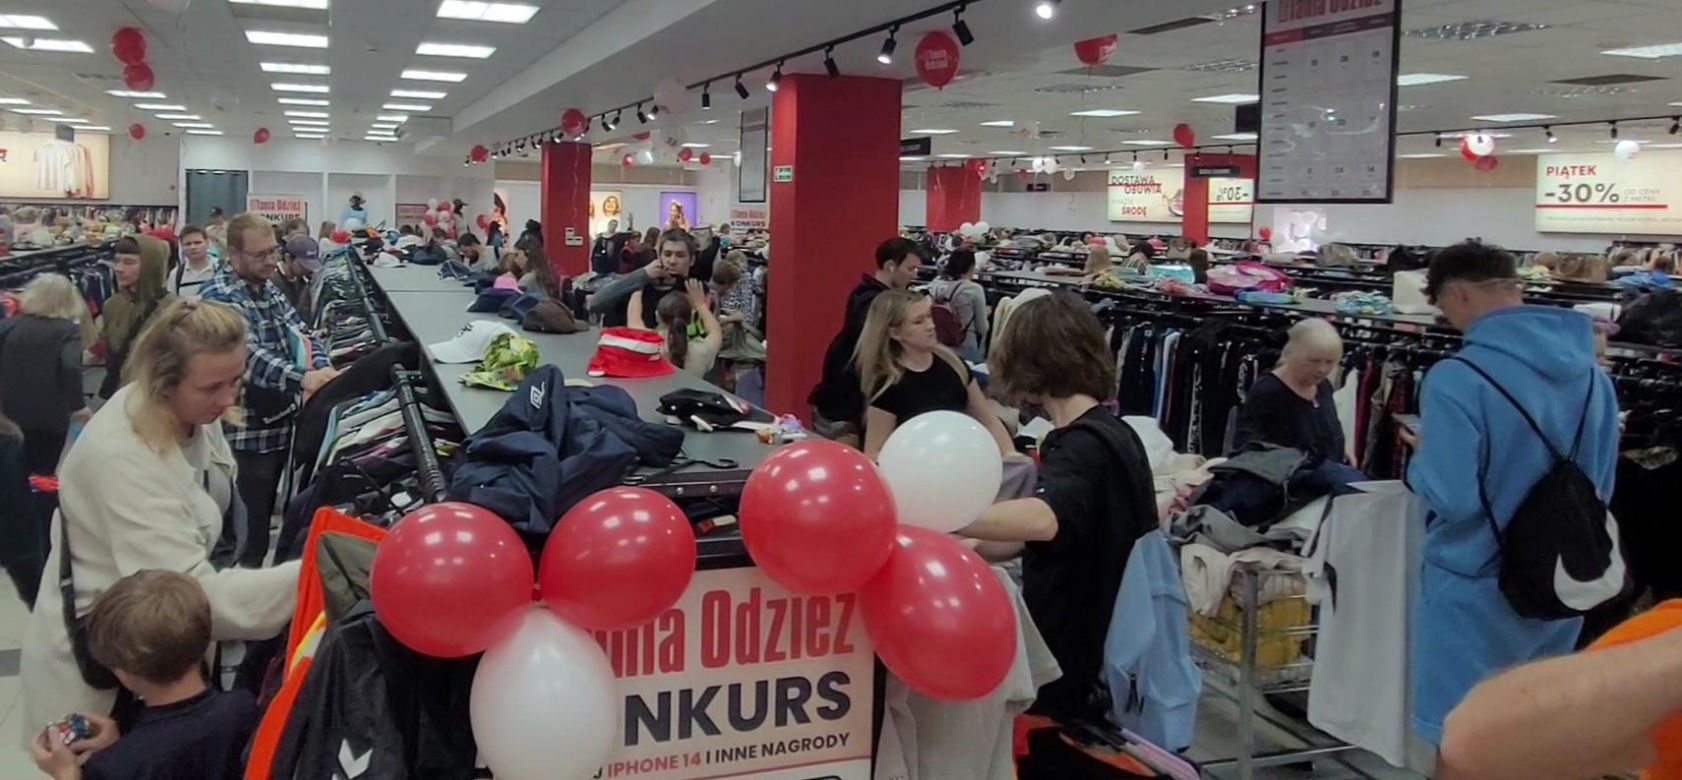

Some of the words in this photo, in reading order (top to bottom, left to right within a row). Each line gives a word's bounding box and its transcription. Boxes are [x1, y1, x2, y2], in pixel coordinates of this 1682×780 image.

[1111, 175, 1155, 186] DOSTAWA
[1546, 165, 1597, 179] PIĄTEK
[1545, 183, 1620, 203] -30%
[607, 755, 679, 778] IPHONE
[683, 751, 703, 767] 14
[714, 744, 758, 764] INNE
[760, 732, 851, 758] NAGRODY
